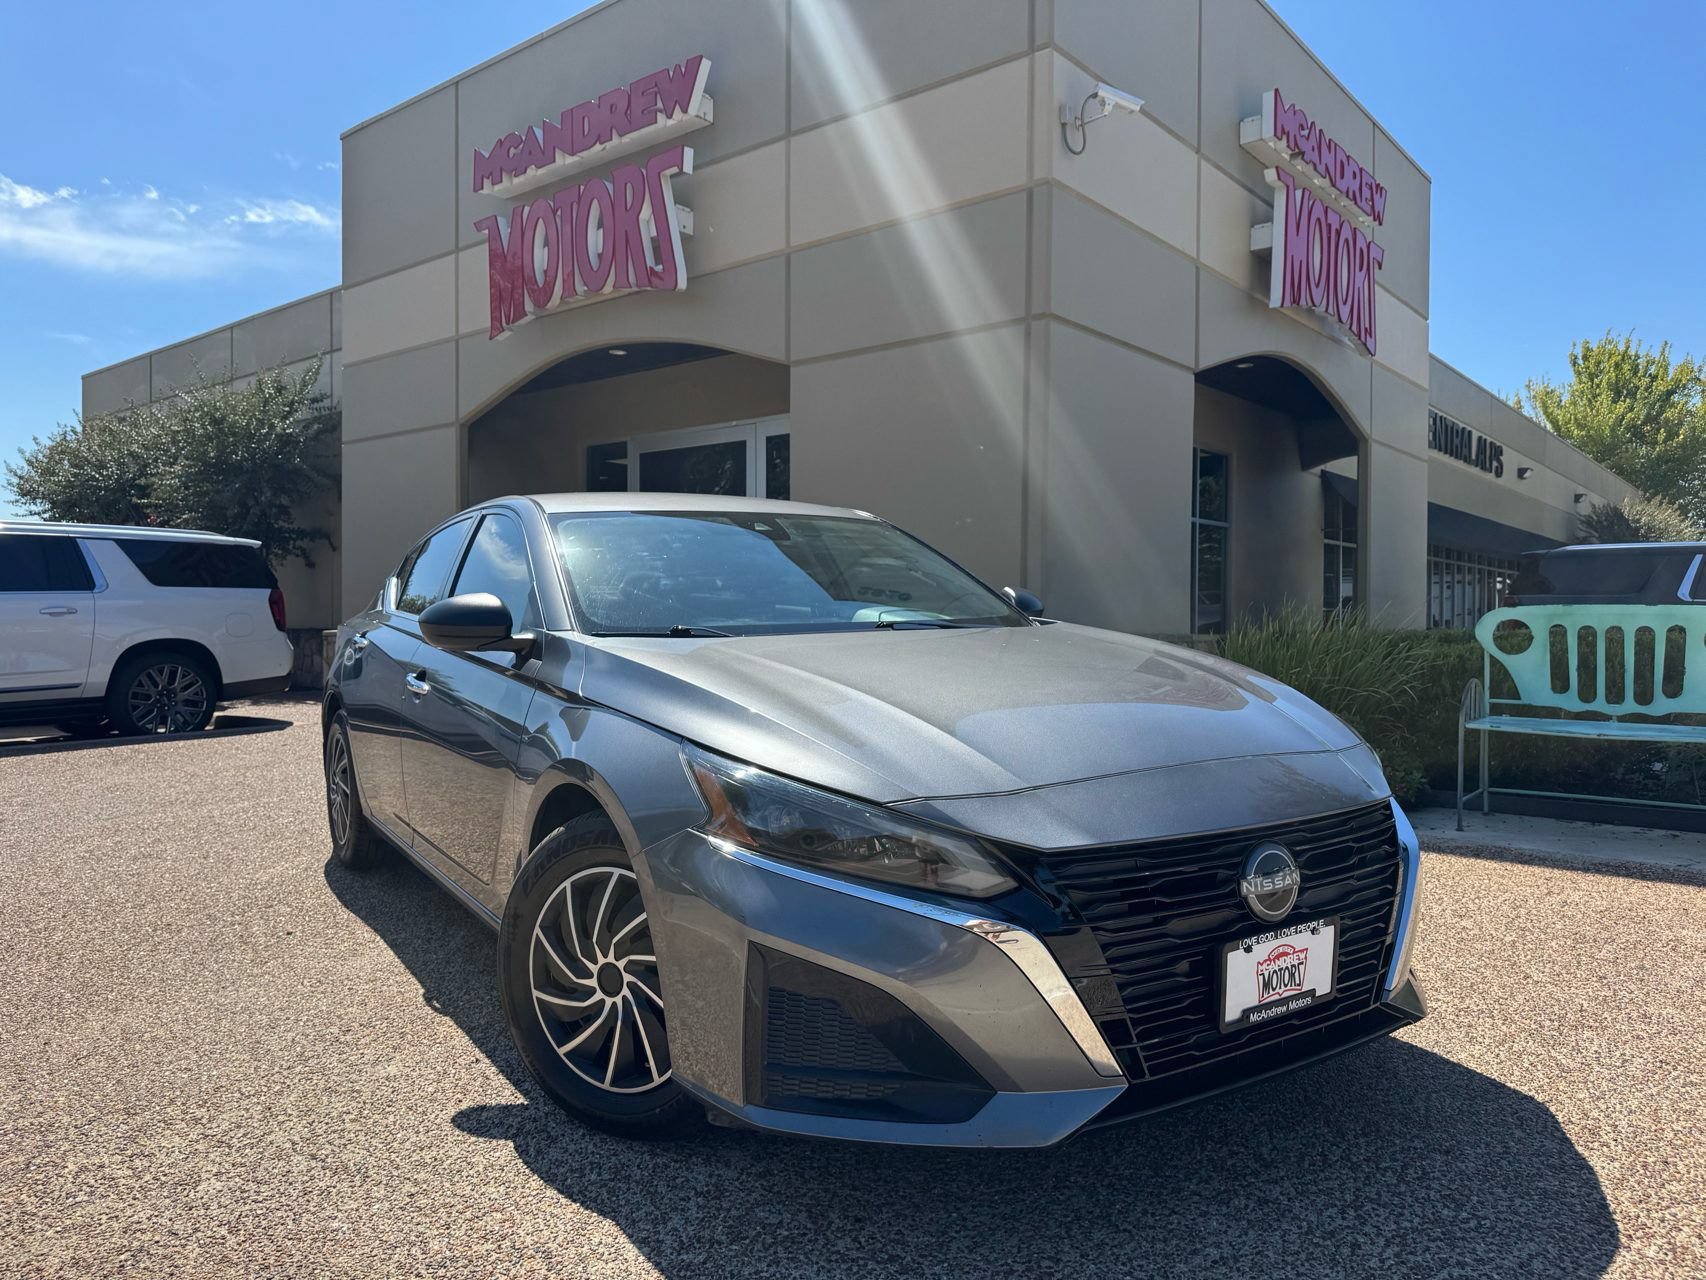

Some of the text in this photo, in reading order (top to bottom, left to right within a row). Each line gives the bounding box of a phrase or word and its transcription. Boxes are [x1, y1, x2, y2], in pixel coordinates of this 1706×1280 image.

[473, 144, 686, 340] MOTORS
[1275, 165, 1384, 357] MOTORS
[1243, 872, 1300, 894] NISSAN
[1239, 920, 1326, 949] LOVE GOD. LOVE PEOPLE.
[1259, 961, 1305, 998] MOTORS
[1249, 996, 1312, 1023] McAndrew Motors
